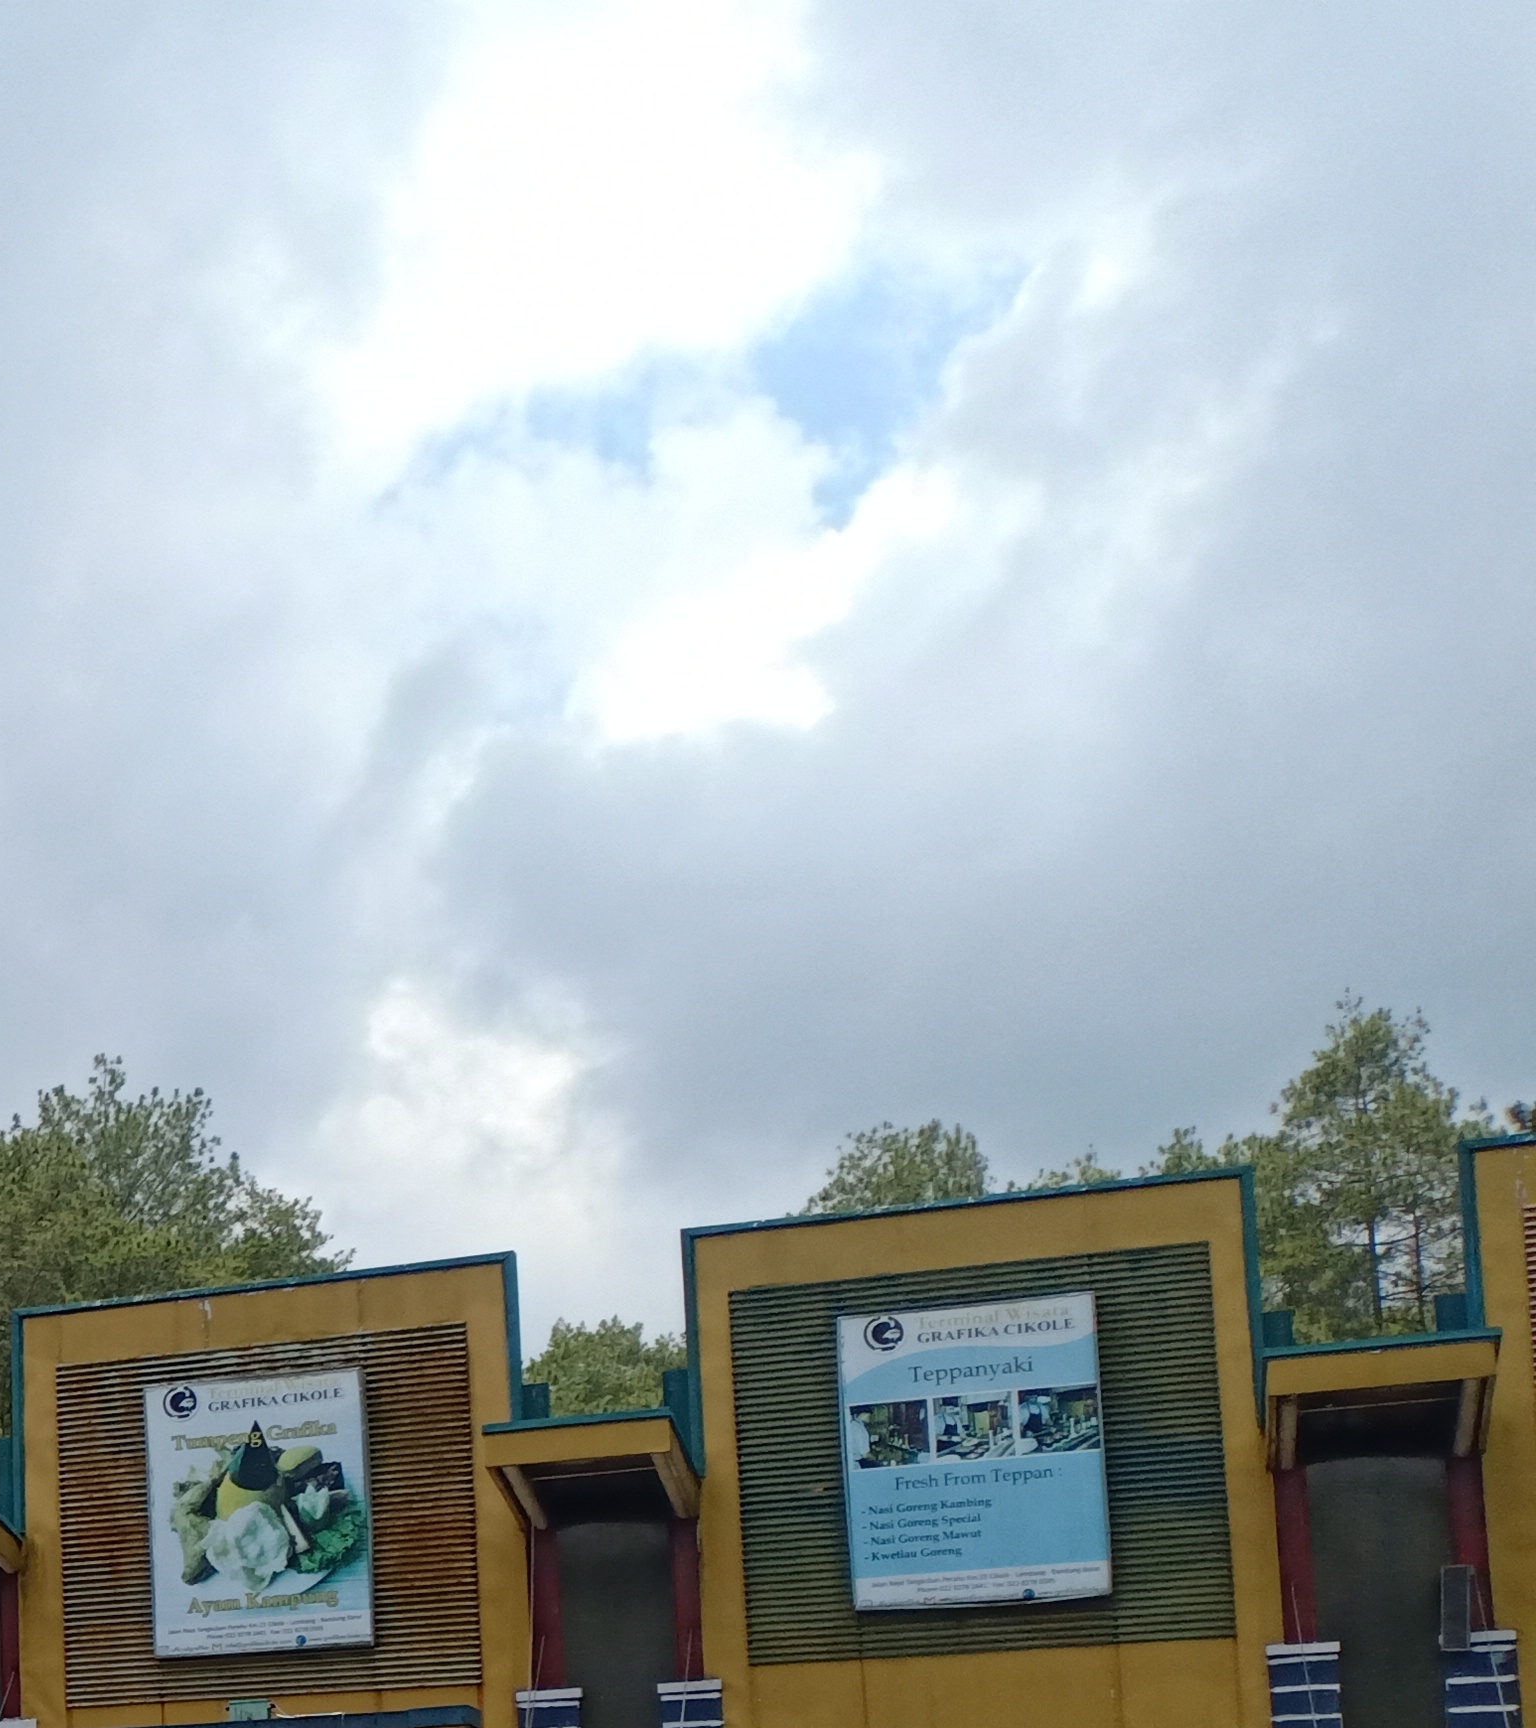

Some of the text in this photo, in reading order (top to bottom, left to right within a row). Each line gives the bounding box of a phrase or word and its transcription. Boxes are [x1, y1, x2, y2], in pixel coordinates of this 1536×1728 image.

[917, 1318, 1076, 1344] GRAFIKA CIKOLE
[908, 1356, 1034, 1386] Teppanyaki
[208, 1387, 345, 1412] GRAFIKA CIKOLE
[894, 1467, 1054, 1491] Fresh From Teppan
[868, 1498, 992, 1515] Nasi Goreng Kambing
[870, 1513, 981, 1530] Nasi Goreng Special
[871, 1529, 982, 1546] Nasi Goreng Mawut
[920, 1547, 962, 1558] Goreng
[186, 1591, 340, 1618] Ayam Kampung
